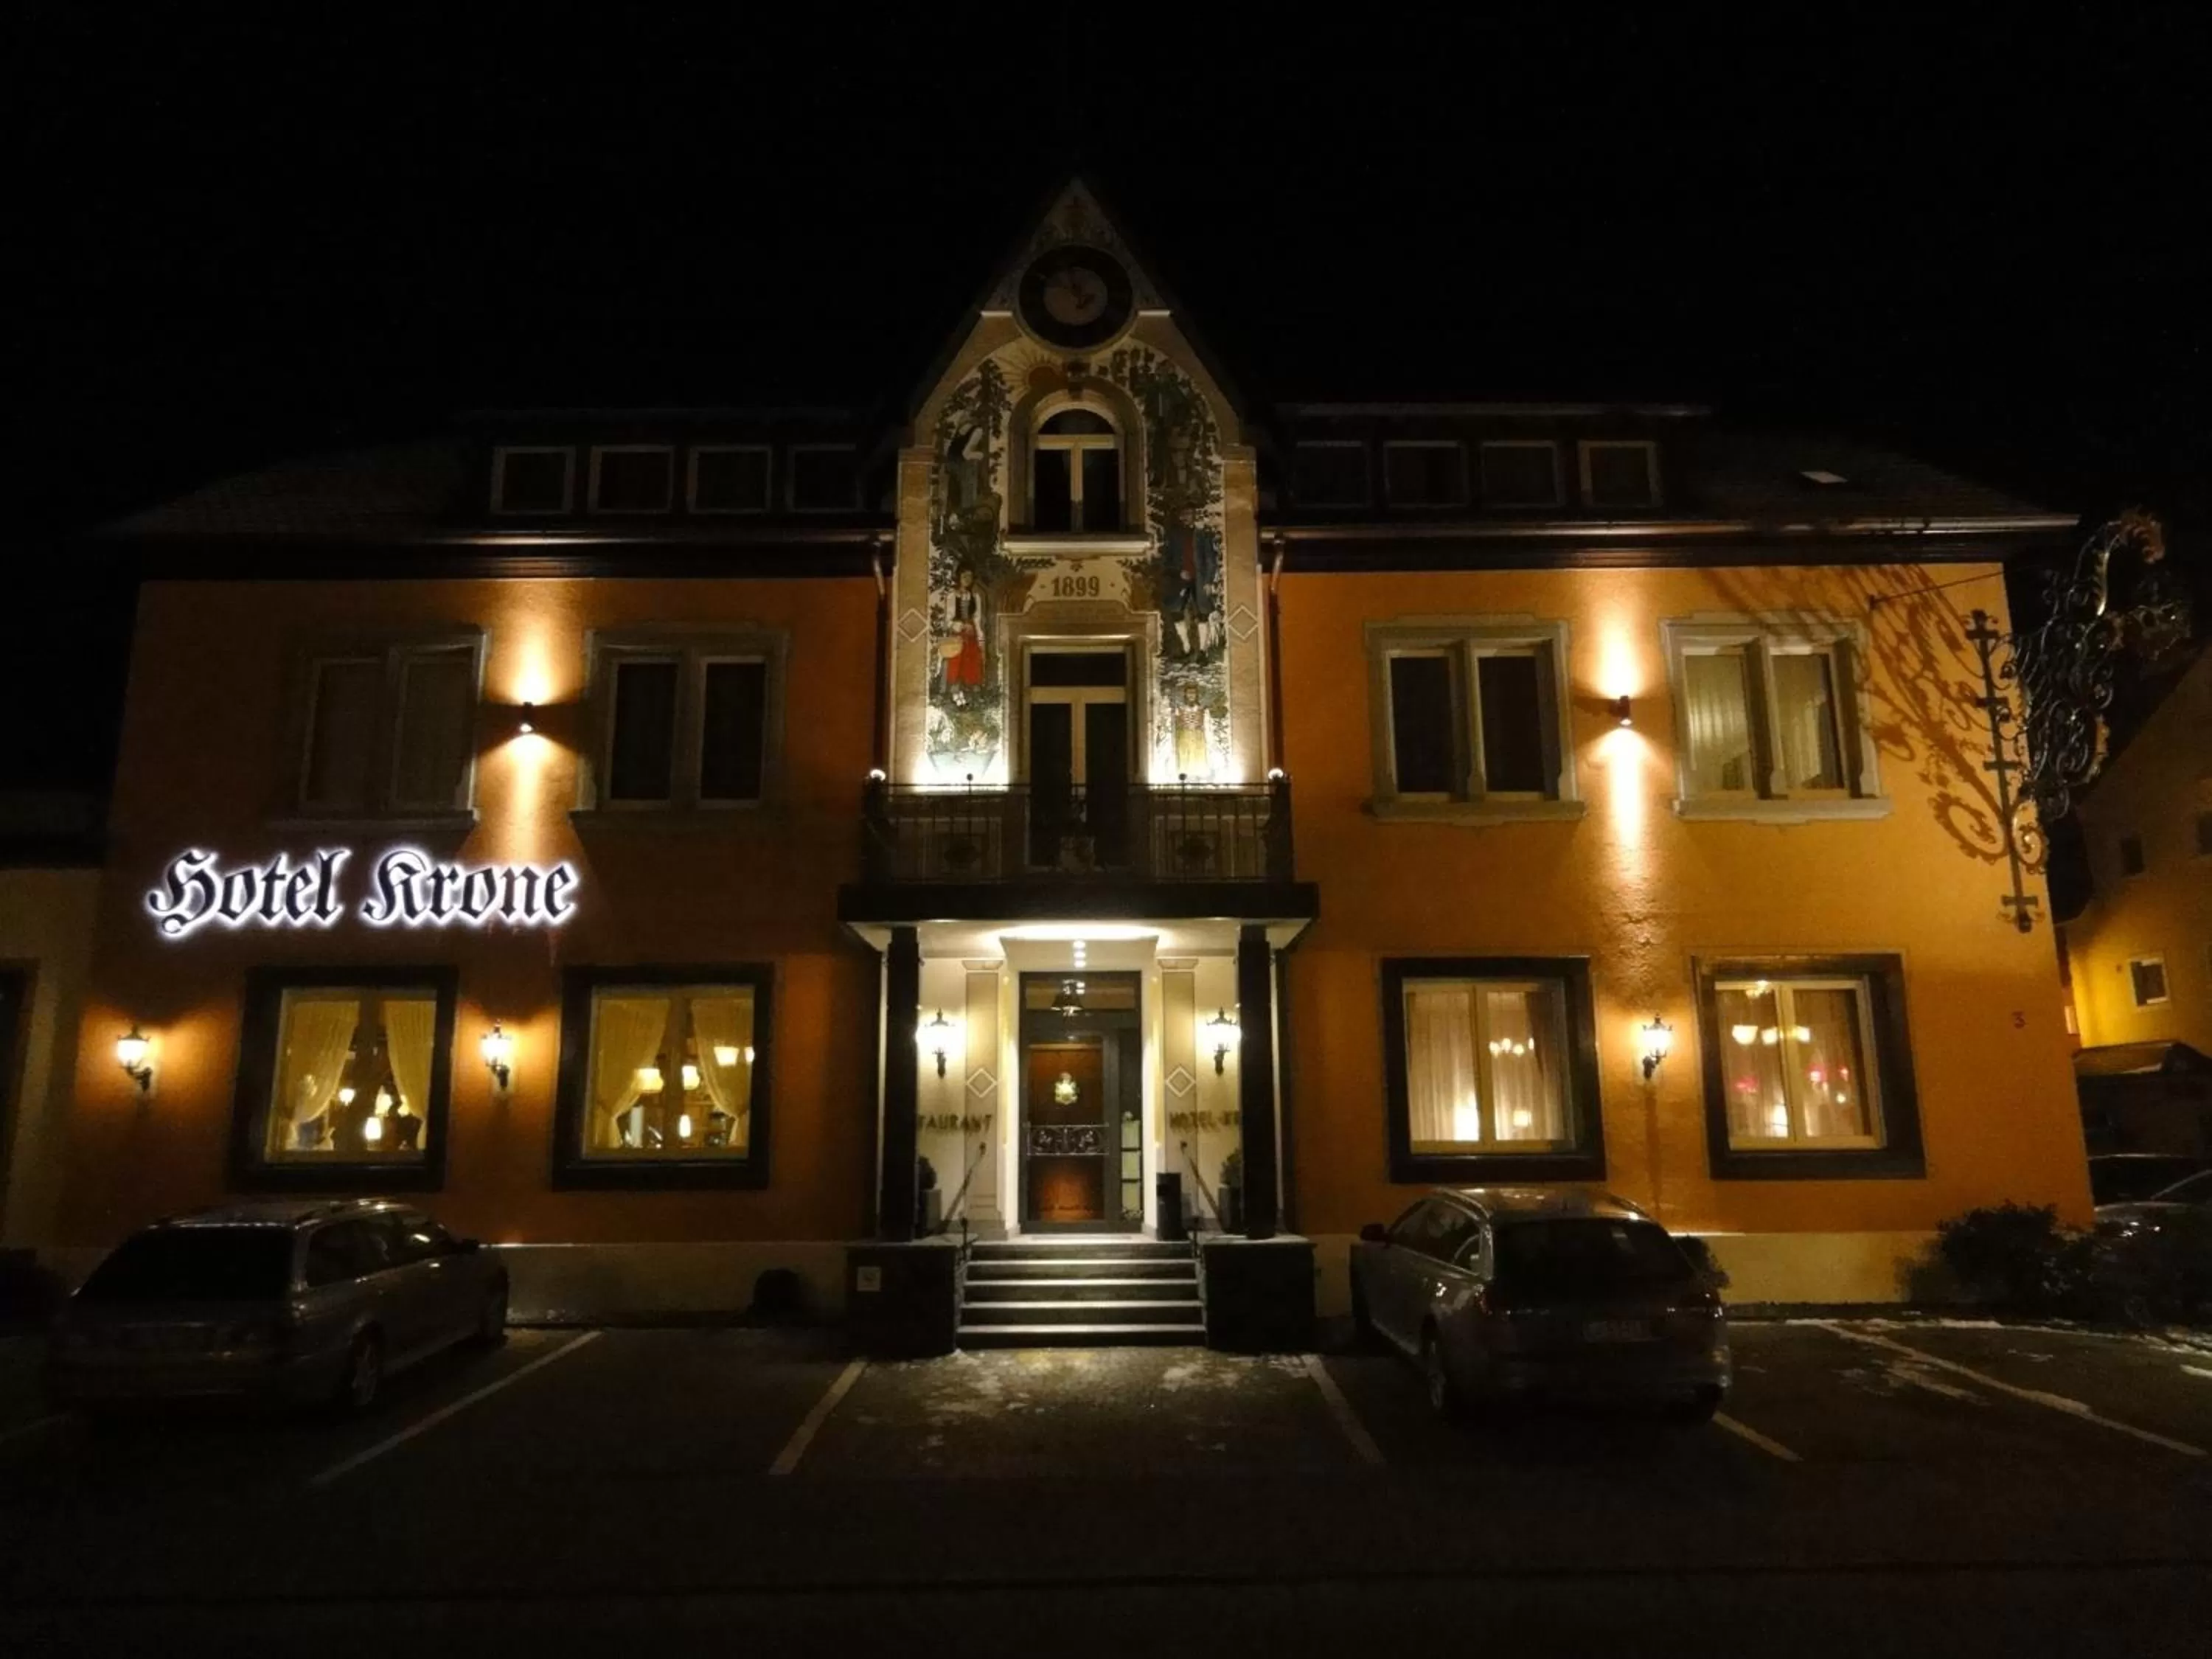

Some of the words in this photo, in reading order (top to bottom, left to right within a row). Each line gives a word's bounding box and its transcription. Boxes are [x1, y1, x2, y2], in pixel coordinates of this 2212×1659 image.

[1051, 575, 1099, 597] 1899
[147, 848, 350, 934] Hotel
[362, 848, 579, 923] Krone
